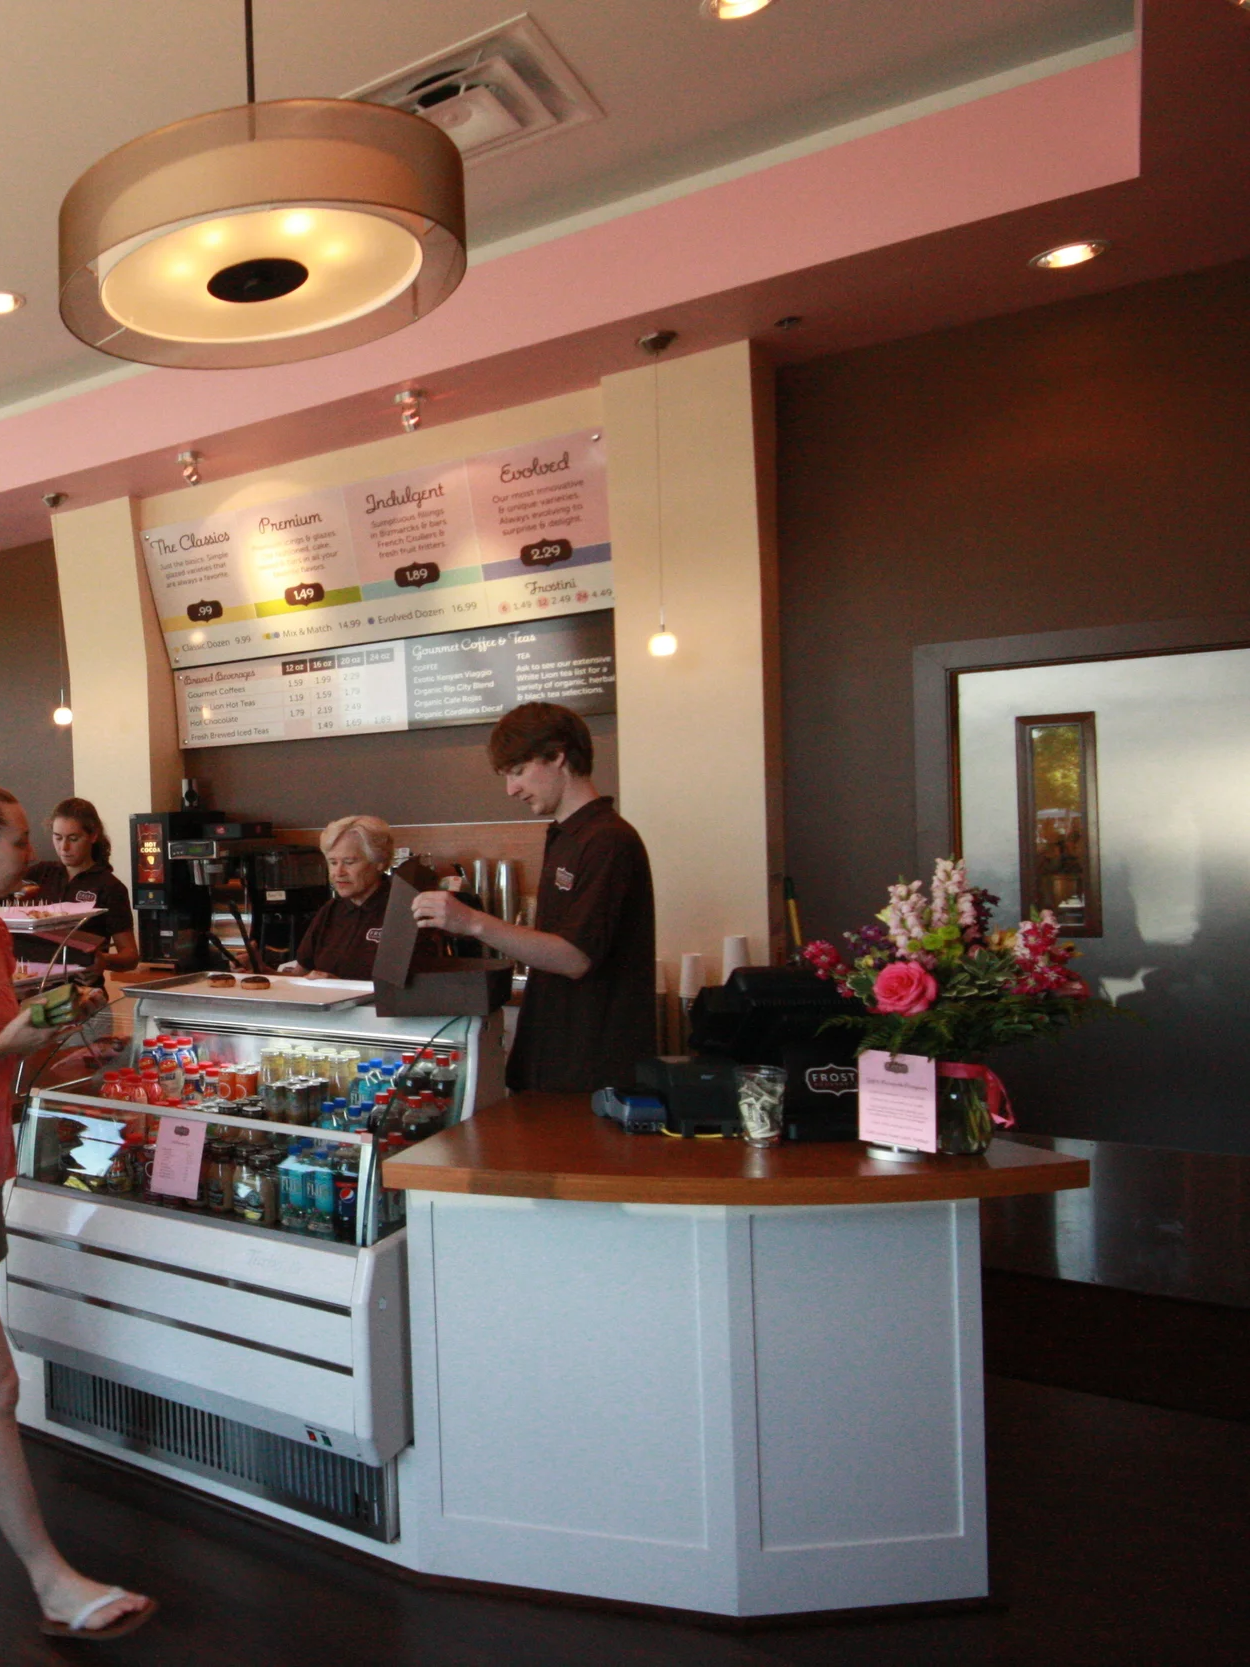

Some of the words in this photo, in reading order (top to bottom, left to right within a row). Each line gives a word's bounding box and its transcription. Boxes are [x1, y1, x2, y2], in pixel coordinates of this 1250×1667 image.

[500, 451, 570, 483] Evolved
[492, 495, 508, 503] Our
[511, 490, 534, 499] most
[536, 480, 584, 495] innovative
[365, 483, 445, 514] Indulgent
[498, 506, 504, 514] &
[507, 501, 537, 513] unique
[500, 514, 530, 524] Always
[531, 506, 571, 519] evolving
[572, 503, 583, 511] to
[258, 512, 322, 535] Premium
[371, 515, 415, 528] Sumptuous
[417, 508, 445, 519] fillings
[429, 519, 447, 527] bars
[502, 525, 537, 536] surprise
[539, 521, 546, 529] &
[150, 539, 178, 555] The
[179, 532, 230, 551] Classics
[377, 538, 404, 548] French
[406, 533, 437, 543] Crullers
[311, 553, 320, 561] all
[321, 550, 338, 560] your
[379, 549, 399, 558] fresh
[400, 546, 417, 555] fruit
[530, 545, 561, 560] 2.29
[160, 563, 173, 571] Just
[173, 560, 184, 568] the
[206, 552, 229, 561] Simple
[165, 570, 186, 580] glazed
[187, 564, 213, 574] varieties
[213, 562, 226, 570] that
[405, 568, 428, 581] 1.89
[177, 577, 198, 586] always
[524, 578, 577, 595] Frostini
[293, 588, 314, 601] 1.49
[501, 604, 508, 612] 6
[513, 600, 532, 611] 1.49
[538, 598, 548, 607] 12
[551, 594, 571, 605] 2.49
[576, 592, 588, 601] 24
[591, 588, 613, 599] 4.49
[198, 605, 213, 616] .99
[181, 641, 205, 652] Classic
[206, 638, 231, 649] Dozen
[234, 635, 251, 645] 9.99
[282, 628, 297, 638] Mix
[299, 627, 306, 636] &
[307, 623, 333, 635] Match
[338, 619, 361, 630] 14.99
[378, 609, 414, 625] Evolved
[414, 607, 445, 618] Dozen
[451, 602, 478, 614] 16.99
[412, 643, 459, 660] Gourmet
[461, 636, 497, 652] Coffee
[497, 637, 506, 646] &
[507, 630, 537, 644] Teas
[340, 657, 350, 665] 20
[351, 656, 361, 664] oz
[370, 653, 380, 661] 24
[380, 652, 390, 660] oz
[515, 652, 531, 660] TEA
[285, 664, 294, 672] 12
[412, 663, 438, 672] COFFEE
[516, 664, 529, 672] Ask
[556, 660, 571, 668] our
[572, 656, 612, 666] extensive
[184, 673, 214, 685] Brewed
[215, 670, 256, 681] Beverages
[315, 676, 332, 684] 1.99
[413, 675, 435, 684] Exotic
[436, 672, 464, 682] Kenyan
[516, 673, 540, 682] White
[540, 671, 559, 679] Lion
[574, 668, 587, 676] list
[588, 666, 600, 674] for
[288, 679, 303, 687] 1.59
[413, 686, 442, 696] Organic
[443, 685, 455, 694] Rip
[456, 683, 472, 692] City
[472, 681, 495, 689] Blend
[516, 682, 543, 692] variety
[543, 680, 553, 688] of
[588, 675, 615, 684] herbal
[187, 690, 217, 699] Gourmet
[219, 686, 246, 695] Coffees
[289, 694, 304, 702] 1.19
[316, 690, 332, 699] 1.59
[517, 693, 523, 701] &
[524, 691, 546, 699] black
[547, 690, 560, 698] tea
[225, 701, 239, 709] Hot
[240, 699, 256, 707] Teas
[414, 699, 442, 708] Organic
[462, 694, 482, 703] Rojas
[290, 709, 305, 717] 1.79
[317, 706, 333, 714] 2.19
[414, 711, 443, 719] Organic
[444, 706, 481, 717] Cordillera
[481, 703, 504, 712] Decaf
[190, 719, 202, 727] Hot
[203, 716, 239, 725] Chocolate
[317, 721, 334, 730] 1.49
[191, 732, 209, 741] Fresh
[210, 729, 236, 739] Brewed
[236, 728, 252, 736] Iced
[253, 727, 270, 735] Teas
[812, 1072, 855, 1082] FROST
